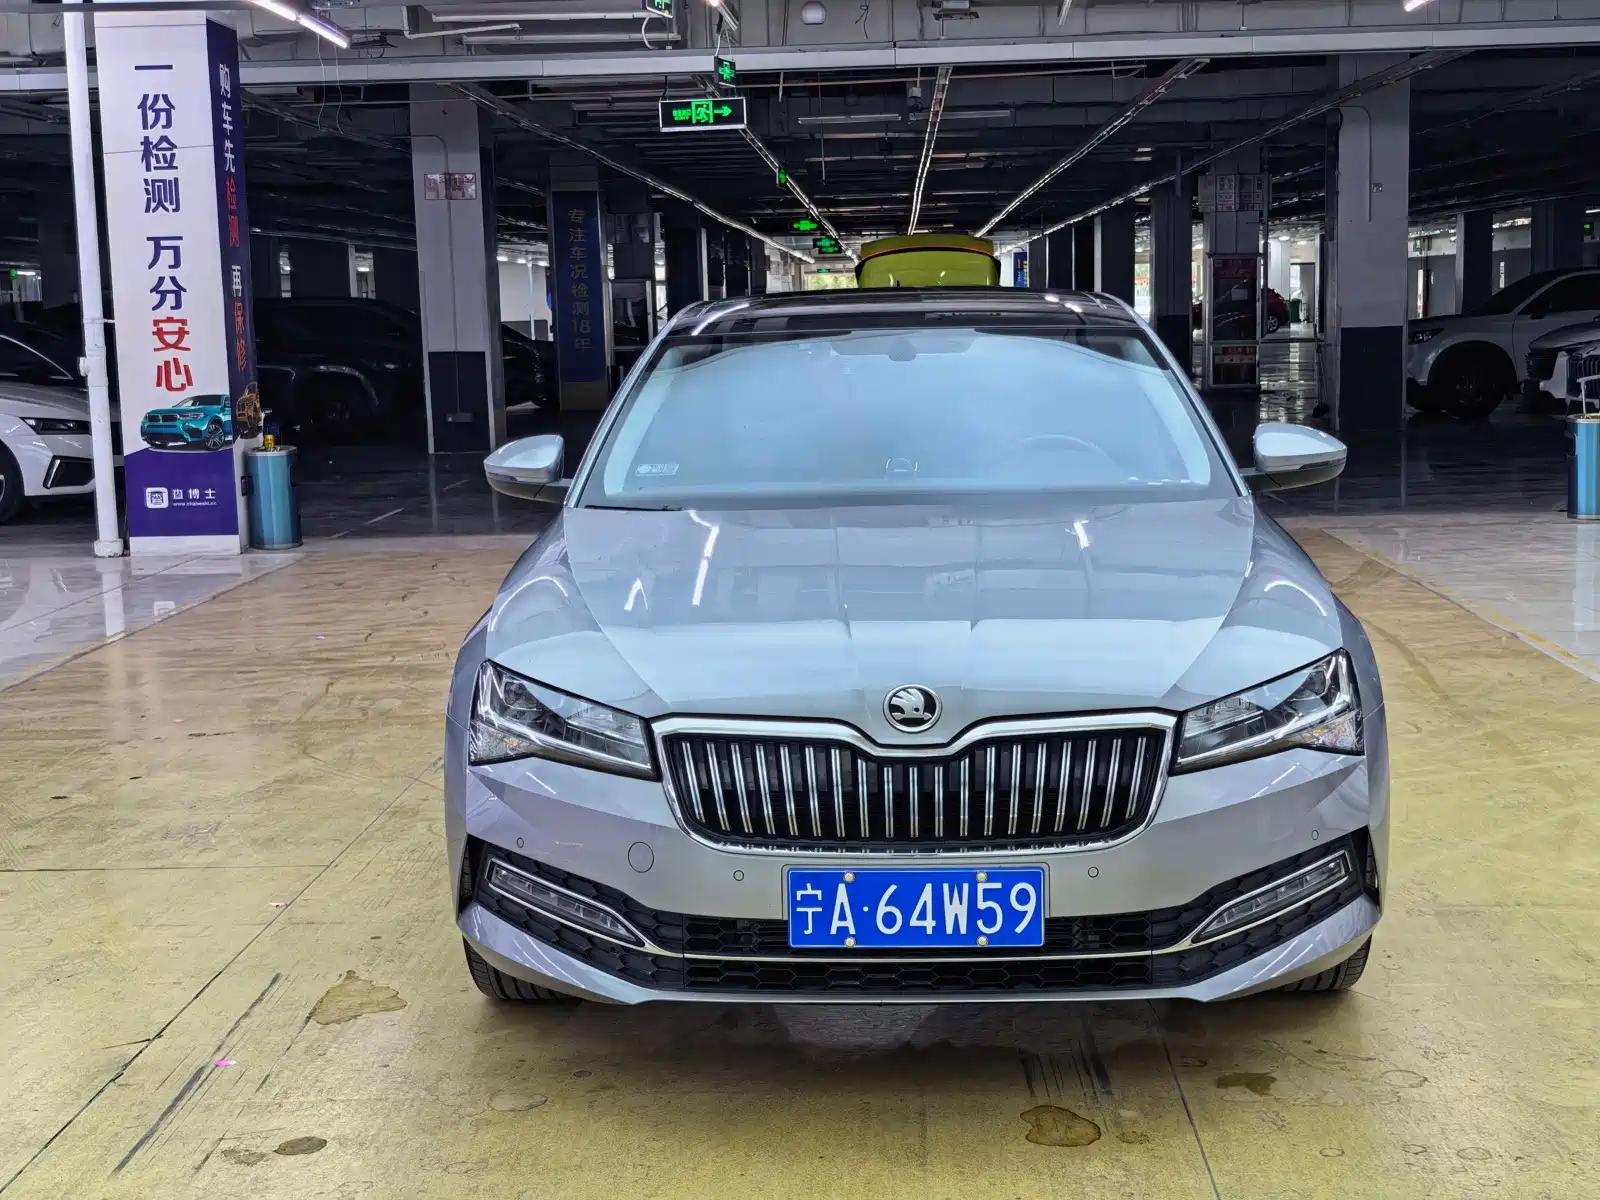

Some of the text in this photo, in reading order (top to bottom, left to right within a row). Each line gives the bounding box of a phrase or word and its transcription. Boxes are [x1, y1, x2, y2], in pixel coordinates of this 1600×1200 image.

[134, 64, 194, 392] 一份检测 万分安心
[219, 63, 241, 248] 购车先检测
